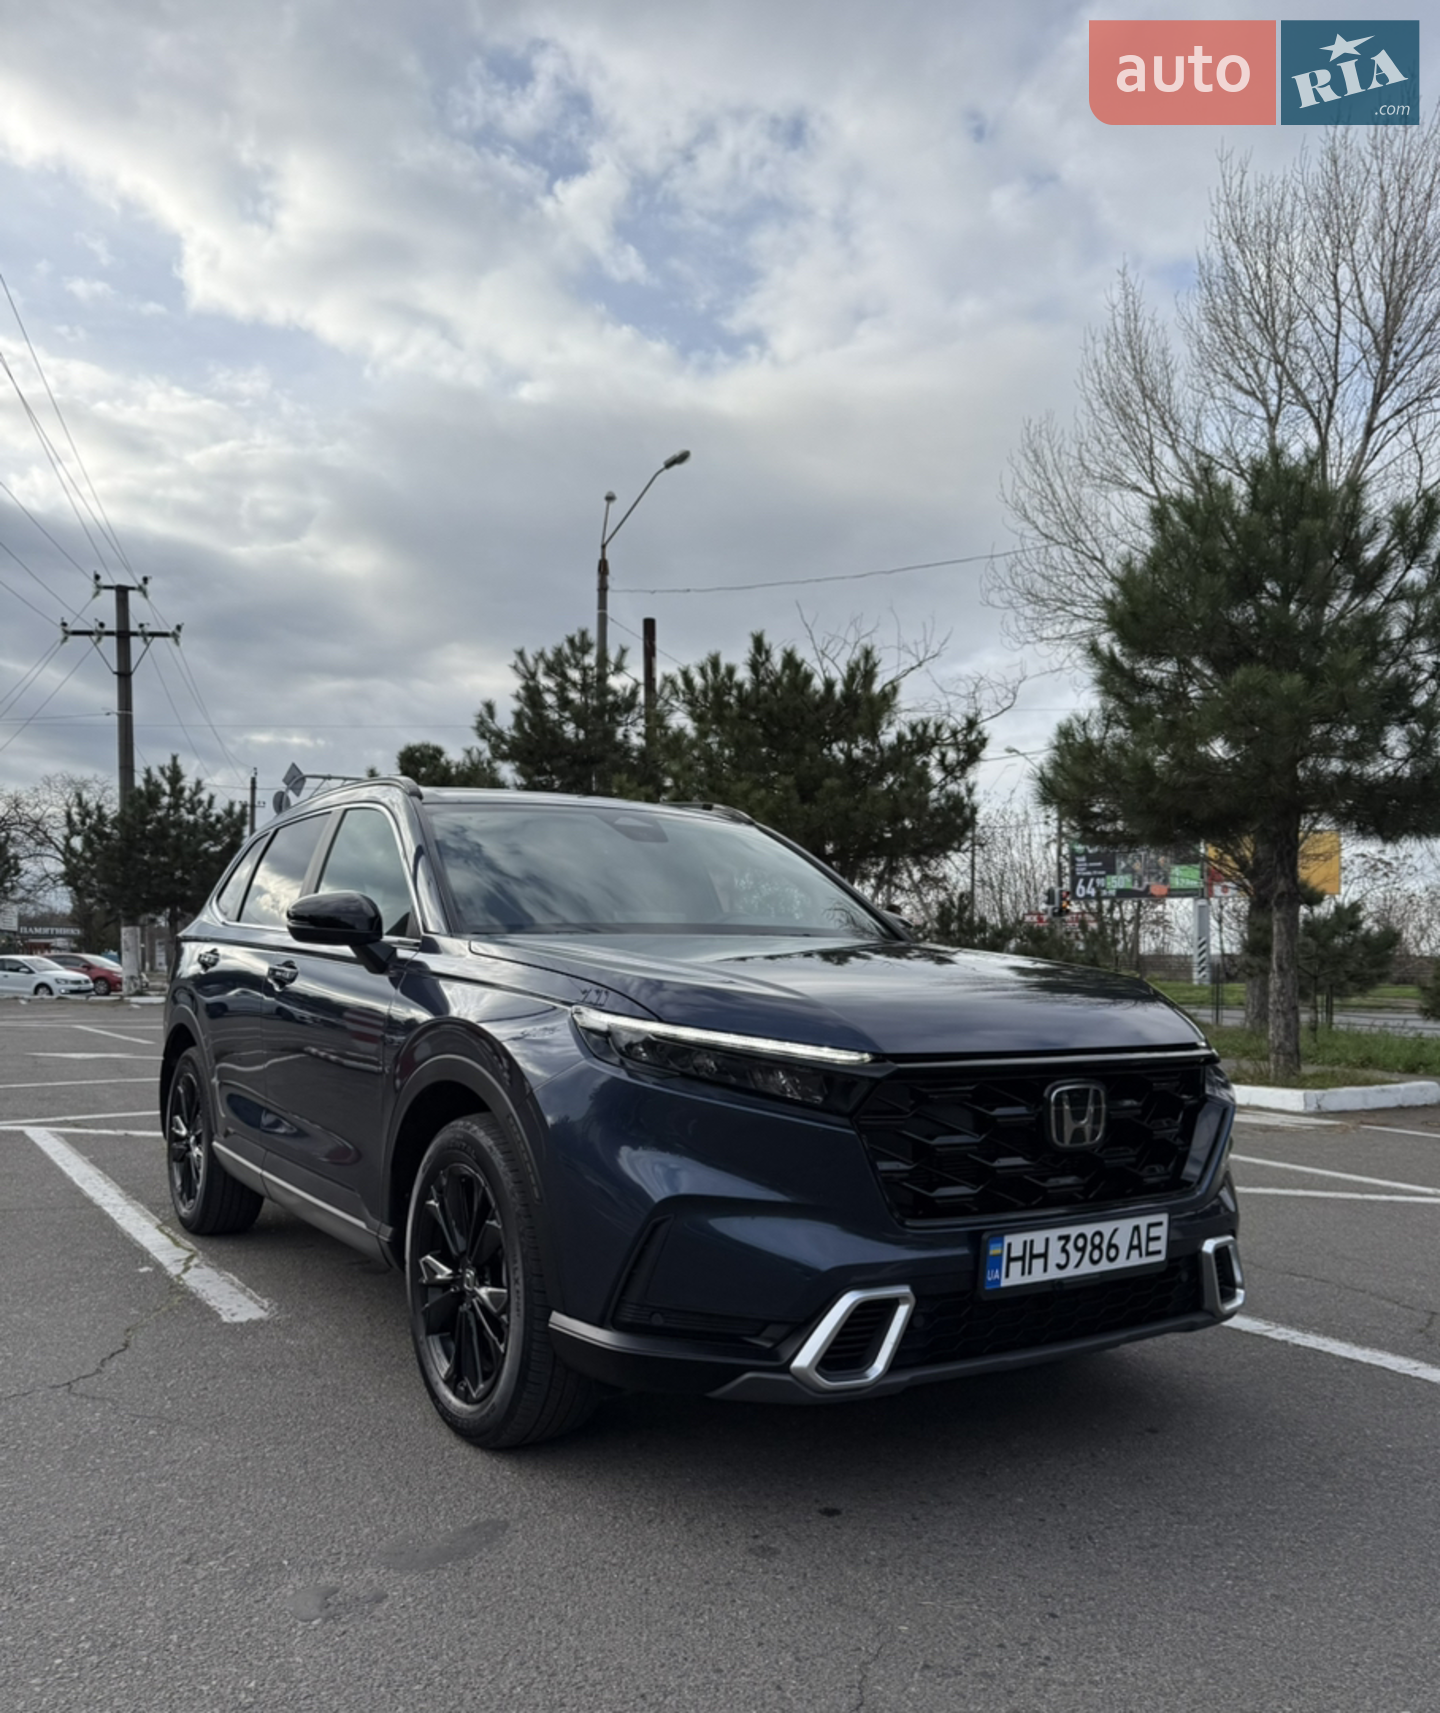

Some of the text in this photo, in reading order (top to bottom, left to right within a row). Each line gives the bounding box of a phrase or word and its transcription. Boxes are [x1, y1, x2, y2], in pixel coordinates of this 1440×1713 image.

[1075, 878, 1096, 898] 64
[1005, 1221, 1164, 1279] HH 3986 AE
[987, 1269, 1000, 1281] UA
